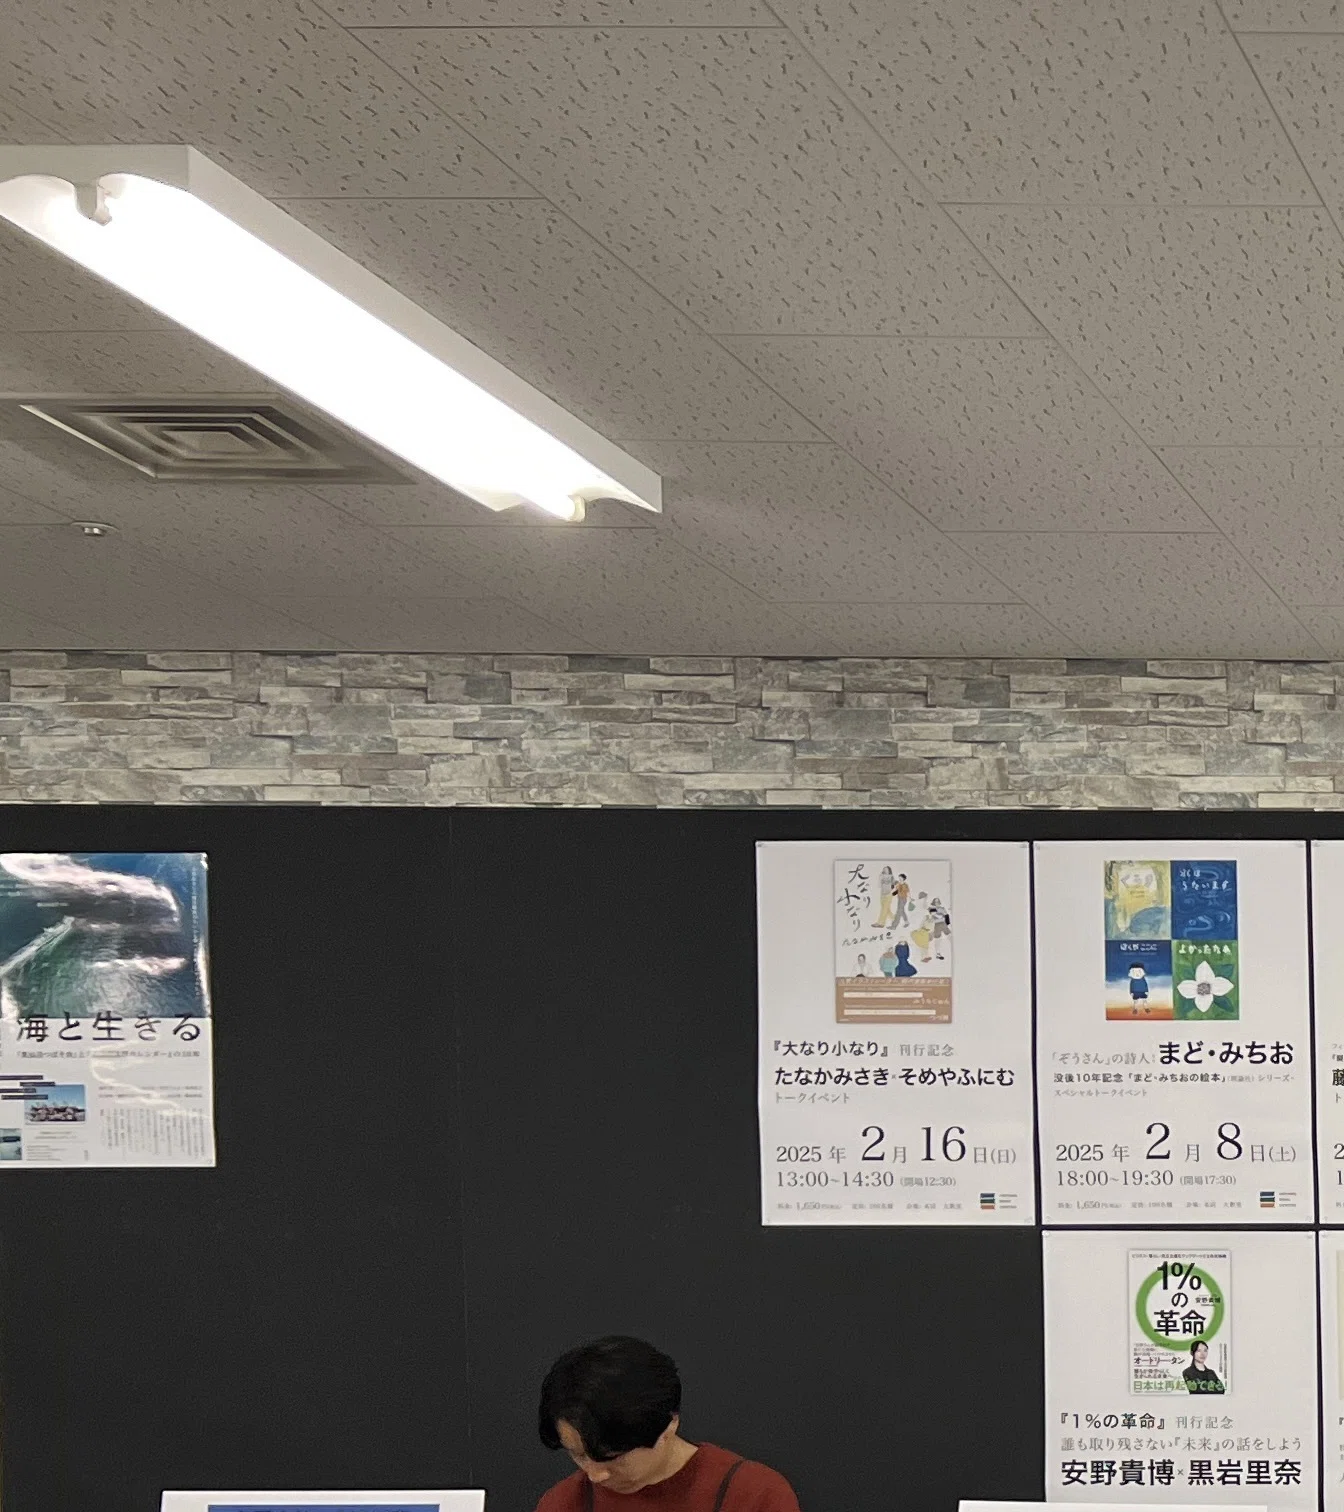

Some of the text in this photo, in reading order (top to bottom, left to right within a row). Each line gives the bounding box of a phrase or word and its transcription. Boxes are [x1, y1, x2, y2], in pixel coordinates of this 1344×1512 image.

[16, 1010, 200, 1042] 海と生きる
[774, 1040, 954, 1057] 『大なり小なり』 刊行記念
[1159, 1040, 1294, 1065] まど・みちお
[776, 1093, 850, 1104] トークイベント
[1054, 1089, 1148, 1097] スペシャルトークイベント
[1157, 1261, 1201, 1290] 1%
[1171, 1292, 1188, 1308] の
[1154, 1310, 1206, 1336] 革命
[1060, 1413, 1233, 1430] 『1%の革命』 刊行記念
[1060, 1437, 1302, 1451] 誰も取り残さない『未来』の話をしよう
[1061, 1458, 1302, 1486] 安野貴博×黒岩里奈
